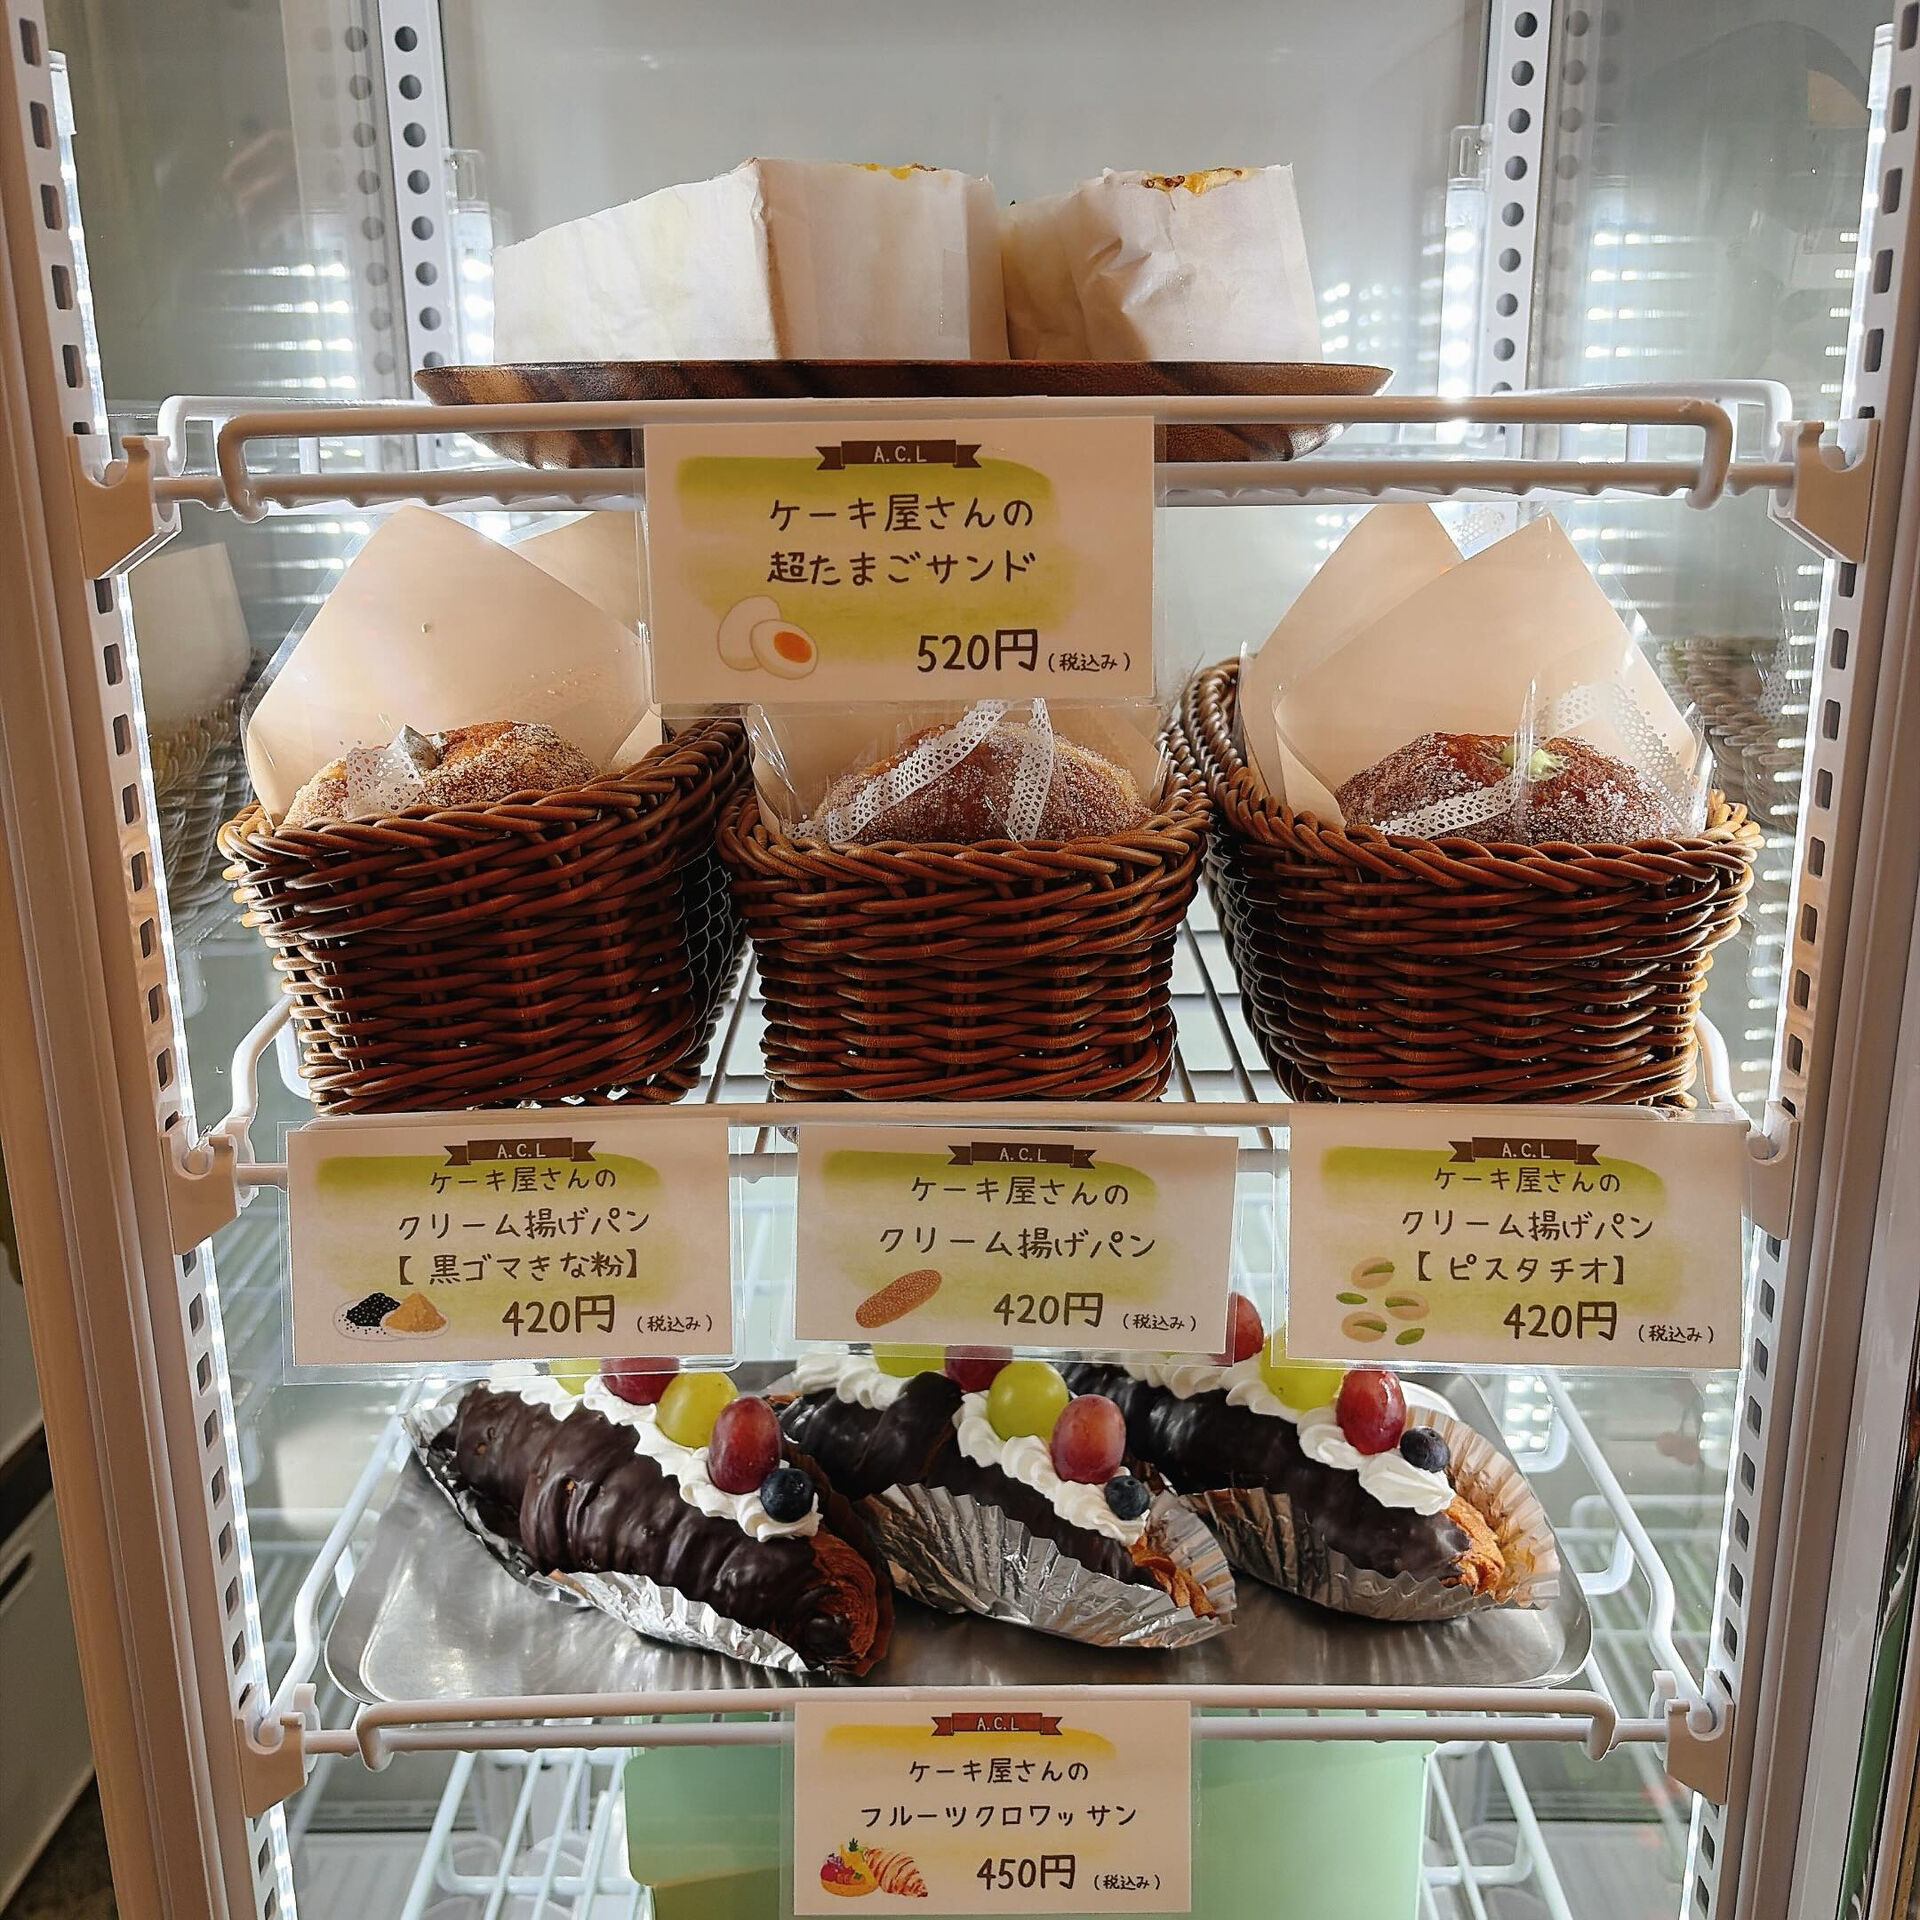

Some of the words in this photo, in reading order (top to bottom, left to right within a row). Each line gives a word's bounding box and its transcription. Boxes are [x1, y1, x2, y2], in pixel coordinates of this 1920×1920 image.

[874, 445, 927, 464] A.C.L
[769, 494, 1033, 531] ケーキ屋さんの
[767, 550, 1036, 586] 超たまごサンド
[917, 629, 1038, 672] 520円
[1047, 652, 1132, 672] (税込み)
[497, 1143, 546, 1159] A.C.L
[1000, 1148, 1047, 1163] A.C.L
[1502, 1142, 1551, 1158] A.C.L
[430, 1167, 616, 1194] ケーキ屋さんの
[911, 1176, 1129, 1205] ケーキ屋さんの
[1435, 1167, 1620, 1193] ケーキ屋さんの
[399, 1208, 649, 1240] クリーム揚げパン
[1402, 1210, 1653, 1241] クリーム揚げパン
[879, 1227, 1155, 1259] クリーム揚げパン
[400, 1248, 638, 1285] 【黒ゴマきな粉】
[1418, 1250, 1624, 1285] 【ピスタチオ】
[502, 1294, 615, 1337] 420円
[637, 1314, 712, 1333] (税込み)
[993, 1292, 1103, 1327] 420円
[1122, 1314, 1197, 1331] (税込み)
[1503, 1301, 1617, 1341] 420円
[1638, 1324, 1714, 1344] (税込み)
[977, 1717, 1019, 1731] A.C.L
[909, 1758, 1089, 1784] ケーキ屋さんの
[861, 1805, 1136, 1827] フルーツクロワッサン
[976, 1854, 1076, 1890] 450円
[1094, 1874, 1161, 1891] (税込み)
